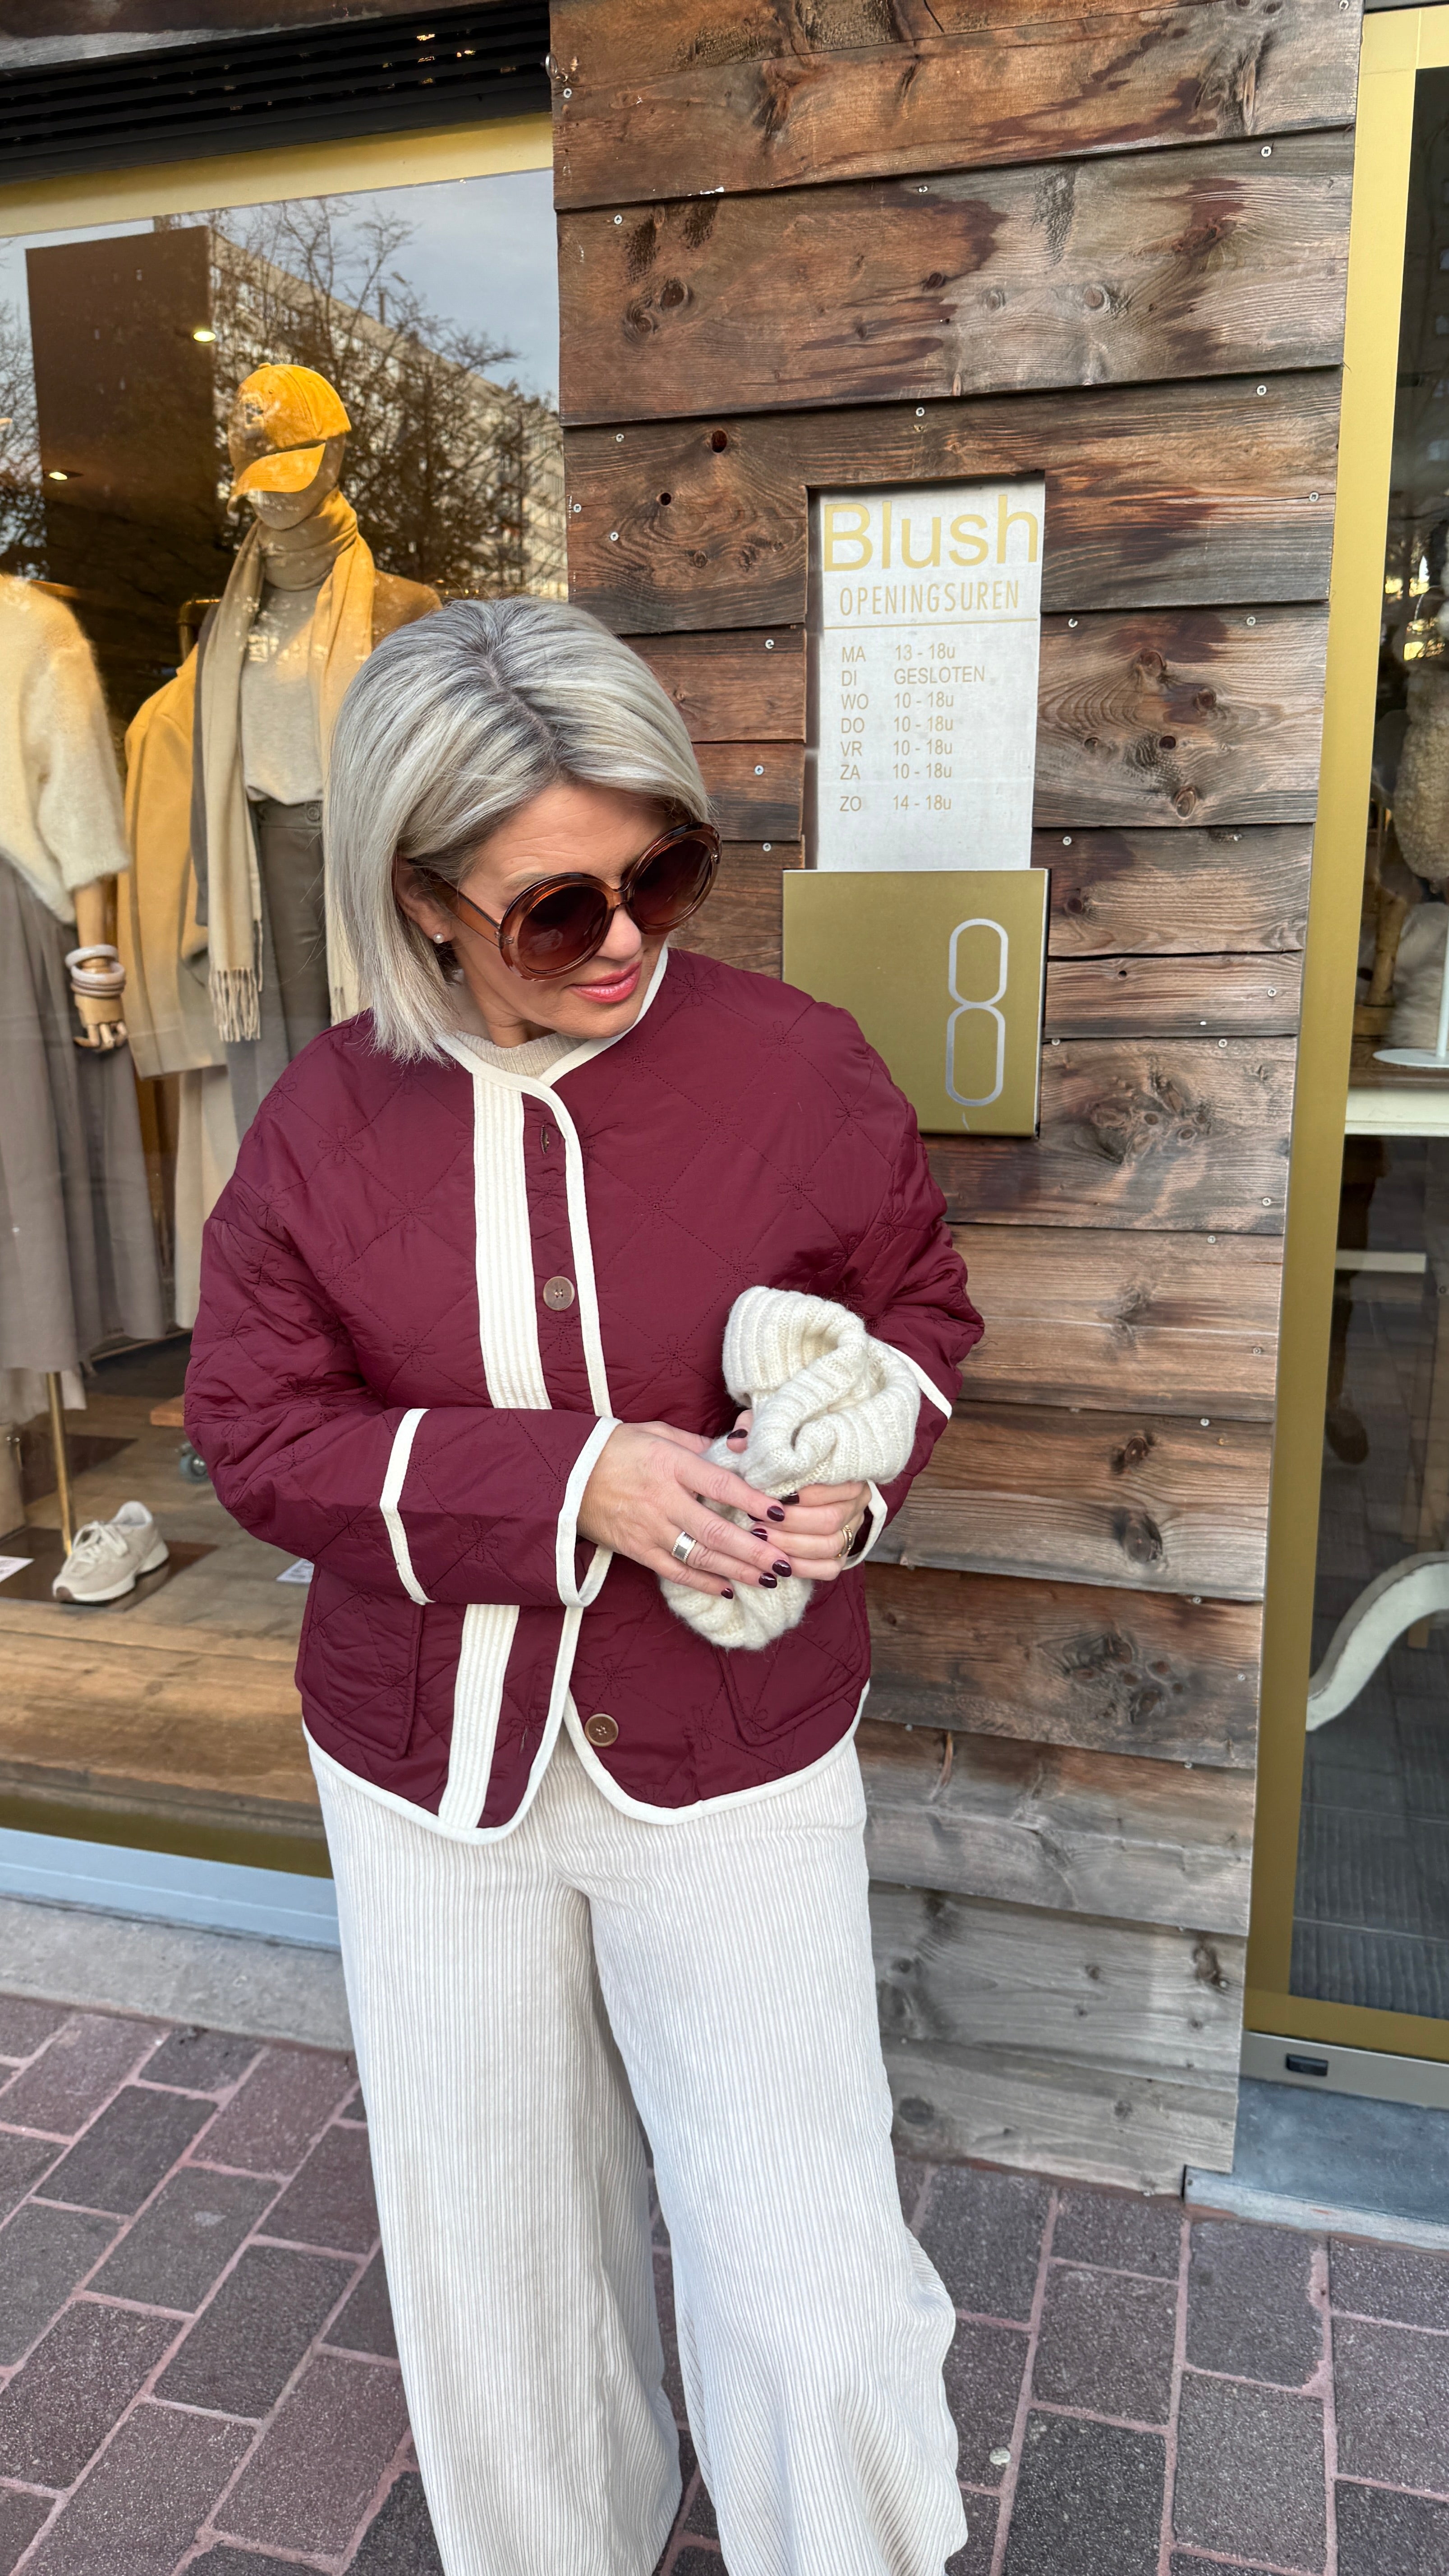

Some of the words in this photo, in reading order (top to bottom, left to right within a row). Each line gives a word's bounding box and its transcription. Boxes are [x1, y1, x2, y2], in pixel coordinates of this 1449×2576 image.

[824, 494, 1038, 572] Blush
[839, 580, 1019, 616] OPENINGSUREN
[842, 646, 866, 663] MA
[895, 644, 912, 661] 13
[929, 643, 956, 660] 18u
[842, 670, 857, 686] DI
[894, 665, 985, 685] GESLOTEN
[841, 693, 869, 710] WO
[894, 692, 911, 708] 10
[927, 691, 954, 708] 18u
[841, 717, 865, 734] DO
[893, 716, 911, 732] 10
[927, 715, 954, 732] 18u
[840, 741, 863, 757] VR
[893, 739, 911, 756] 10
[926, 739, 953, 755] 18u
[840, 764, 861, 780] ZA
[892, 763, 910, 779] 10
[926, 762, 952, 779] 18u
[839, 796, 862, 812] ZO
[892, 794, 909, 811] 14
[925, 794, 952, 810] 18u
[945, 918, 1009, 1107] 8
